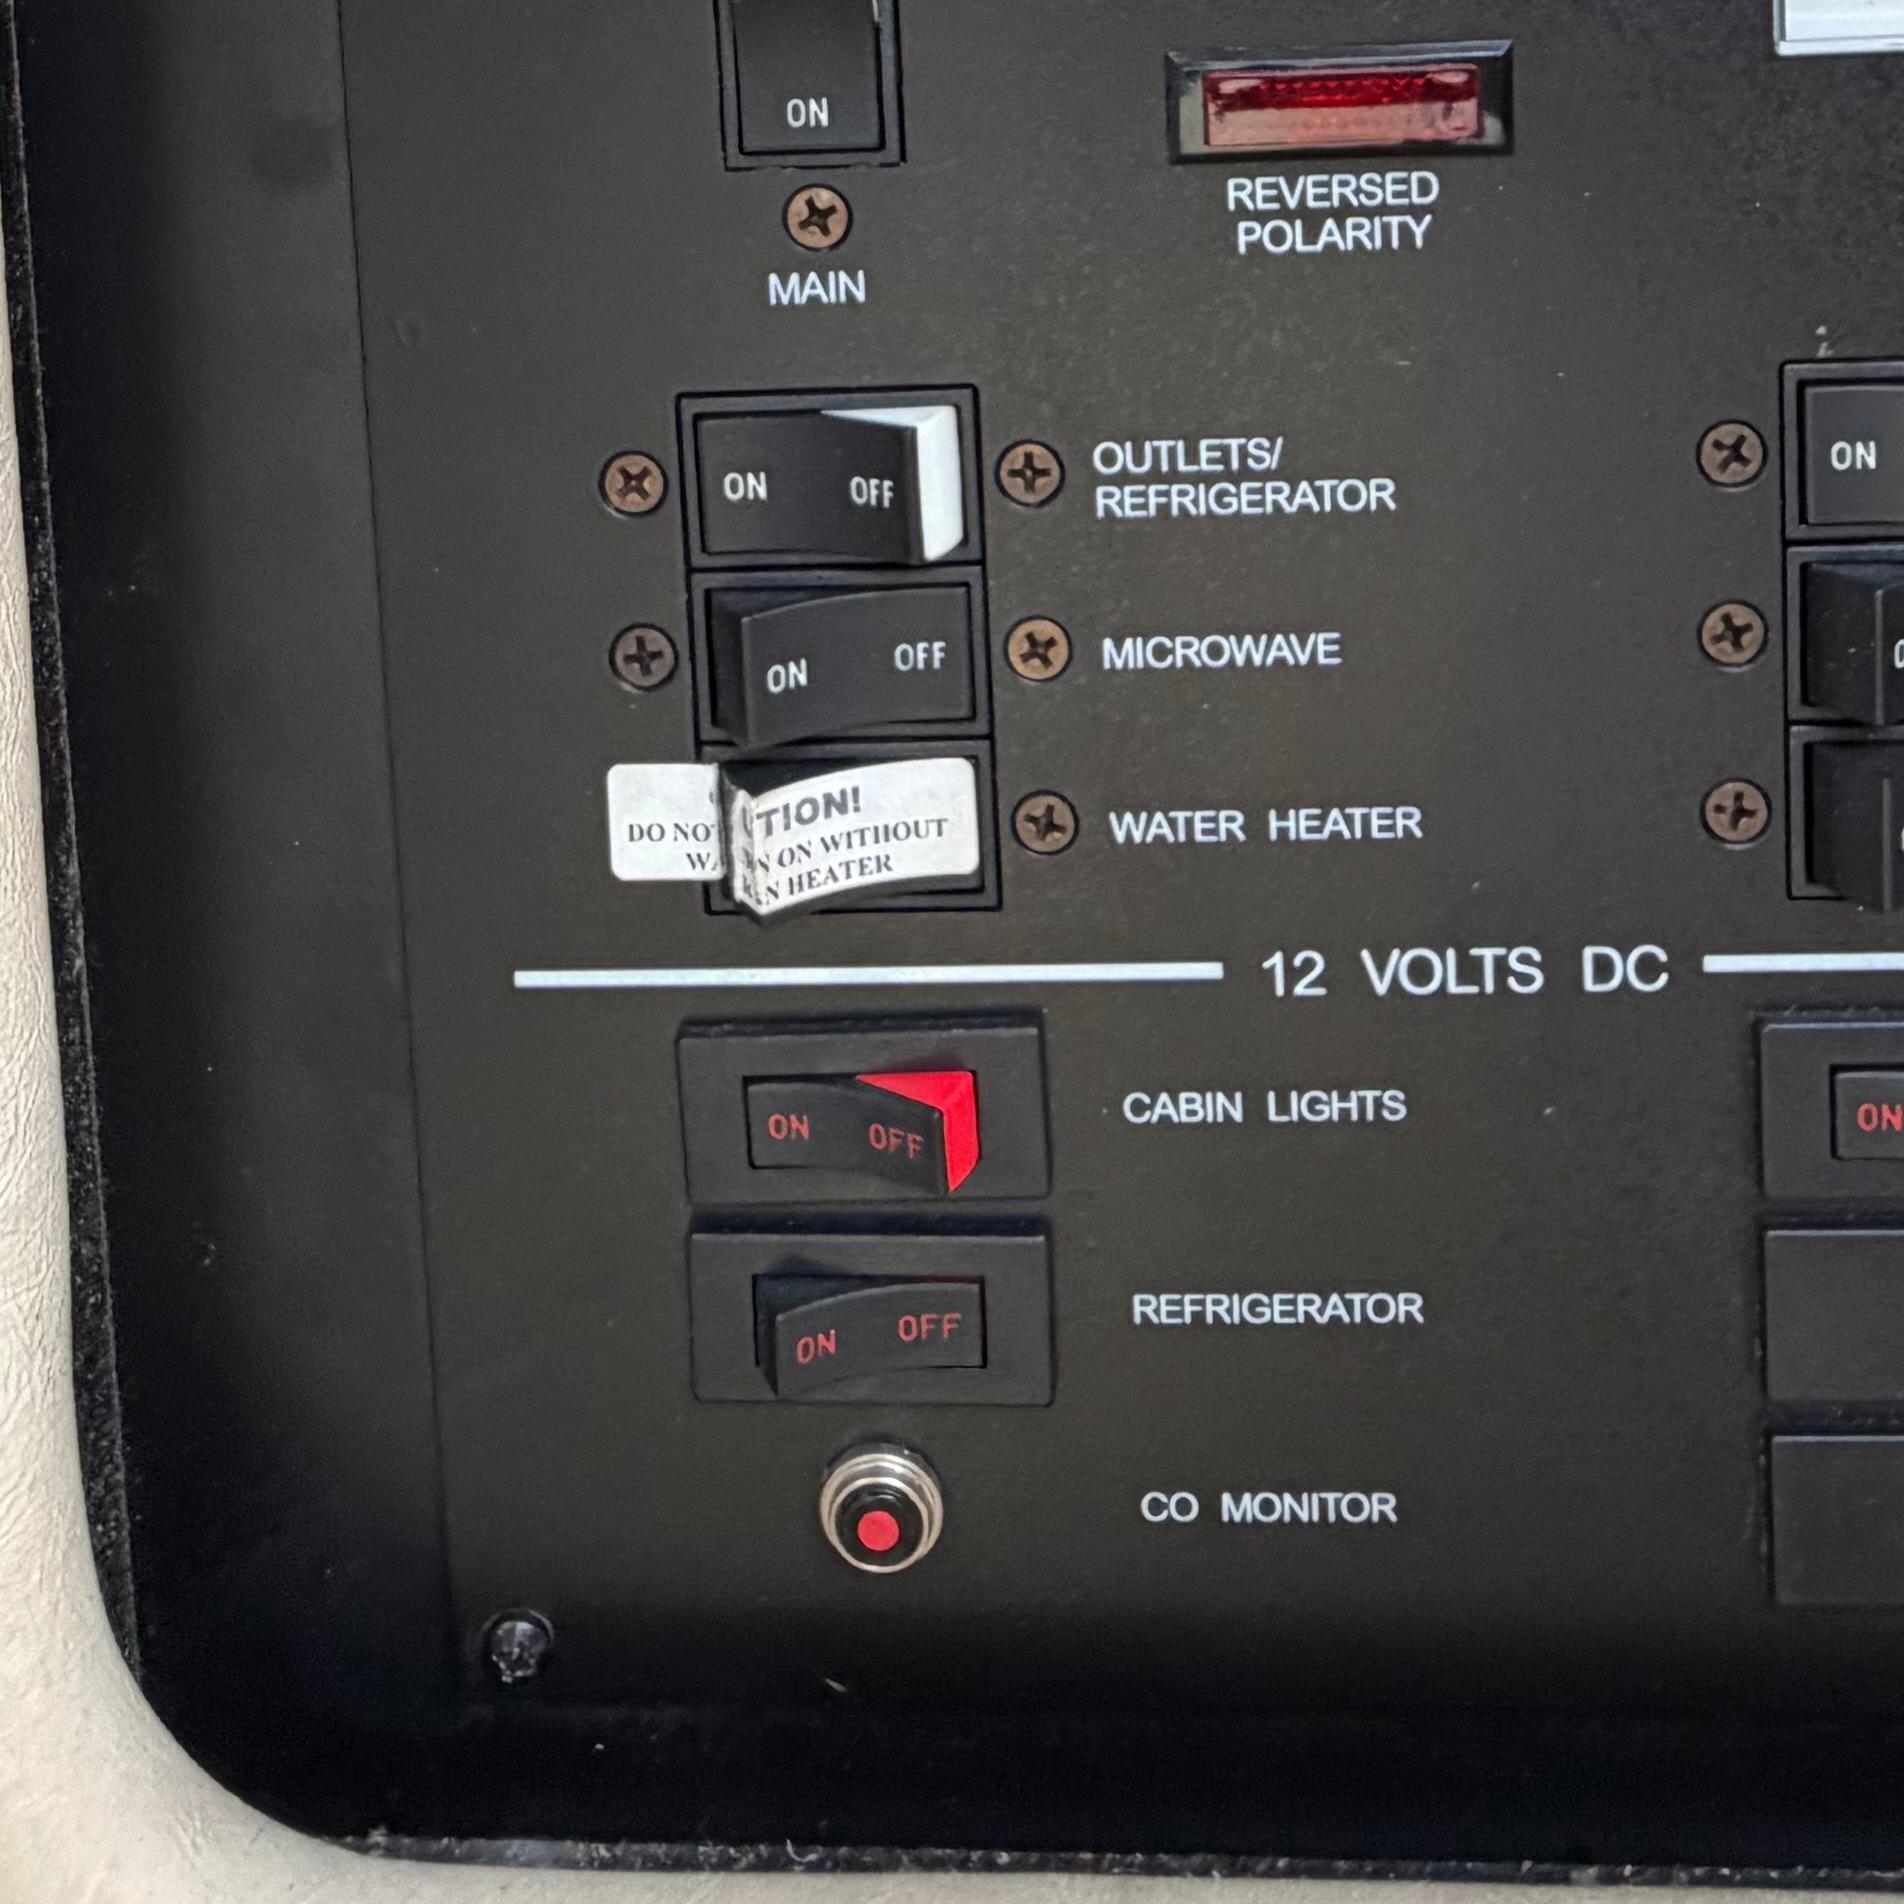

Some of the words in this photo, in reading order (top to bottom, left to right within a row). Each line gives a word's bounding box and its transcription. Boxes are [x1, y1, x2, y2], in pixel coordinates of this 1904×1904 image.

[787, 97, 829, 129] ON
[1227, 170, 1440, 211] REVERSED
[1237, 213, 1433, 256] POLARITY
[768, 269, 867, 306] MAIN
[1092, 435, 1284, 475] OUTLETS/
[1830, 440, 1876, 471] ON
[723, 472, 768, 503] ON
[850, 475, 895, 509] OFF
[1094, 477, 1398, 520] REFRIGERATOR
[895, 641, 947, 672] OFF
[1101, 631, 1342, 671] MICROWAVE
[767, 657, 807, 694] ON
[628, 823, 665, 842] DO
[673, 823, 716, 842] NO
[777, 840, 813, 868] ON
[821, 818, 948, 855] WITHOUT
[1108, 809, 1246, 845] WATER
[1268, 806, 1423, 842] HEATER
[793, 854, 893, 895] HEATER
[1260, 950, 1327, 998] 12
[1360, 946, 1543, 995] VOLTS
[1582, 945, 1669, 994] DC
[1123, 1090, 1244, 1125] CABIN
[1267, 1088, 1408, 1124] LIGHTS
[1857, 1102, 1904, 1134] ON
[768, 1113, 810, 1143] ON
[868, 1123, 925, 1159] OFF
[1132, 1292, 1424, 1326] REFRIGERATOR
[897, 1312, 963, 1343] OFF
[796, 1329, 838, 1365] ON
[1140, 1492, 1200, 1525] CO
[1221, 1491, 1399, 1525] MONITOR
